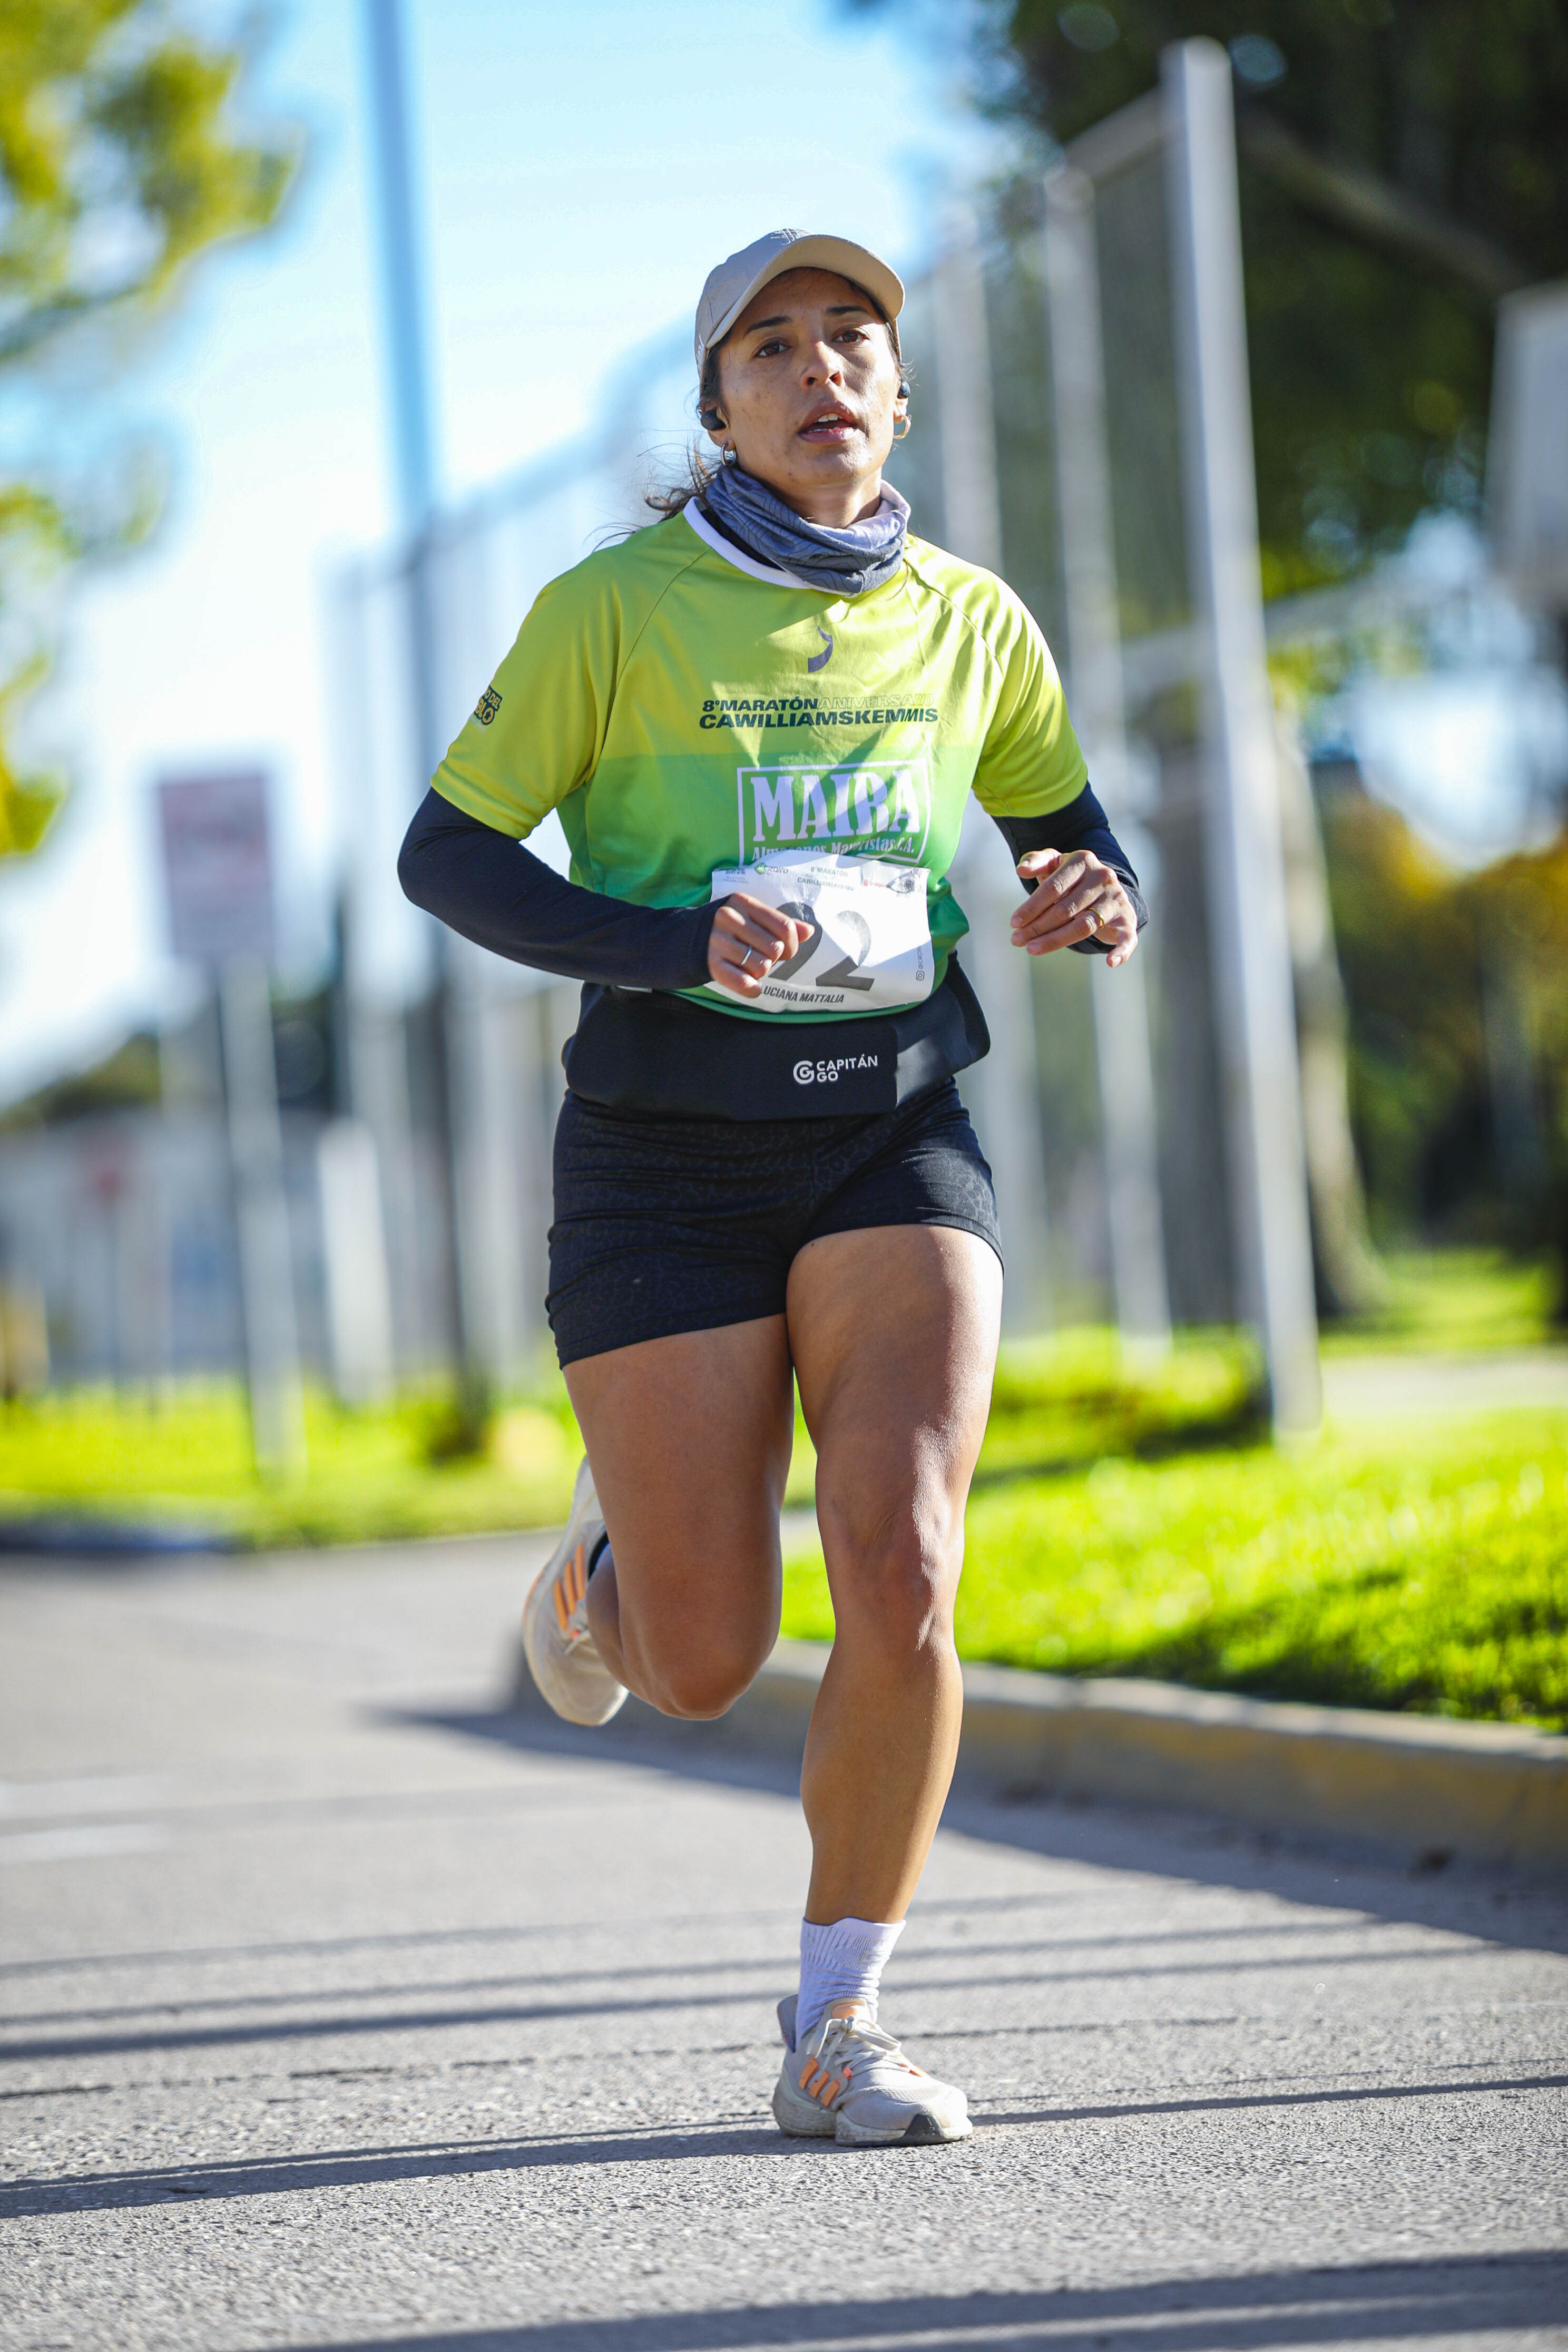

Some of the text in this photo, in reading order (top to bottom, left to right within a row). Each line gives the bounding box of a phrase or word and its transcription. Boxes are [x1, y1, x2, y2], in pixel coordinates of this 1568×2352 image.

[750, 768, 920, 841] MAIRA
[762, 986, 845, 1003] UCIANA MATTALIA
[816, 1054, 878, 1071] CAPITÁN
[816, 1070, 839, 1082] GO
